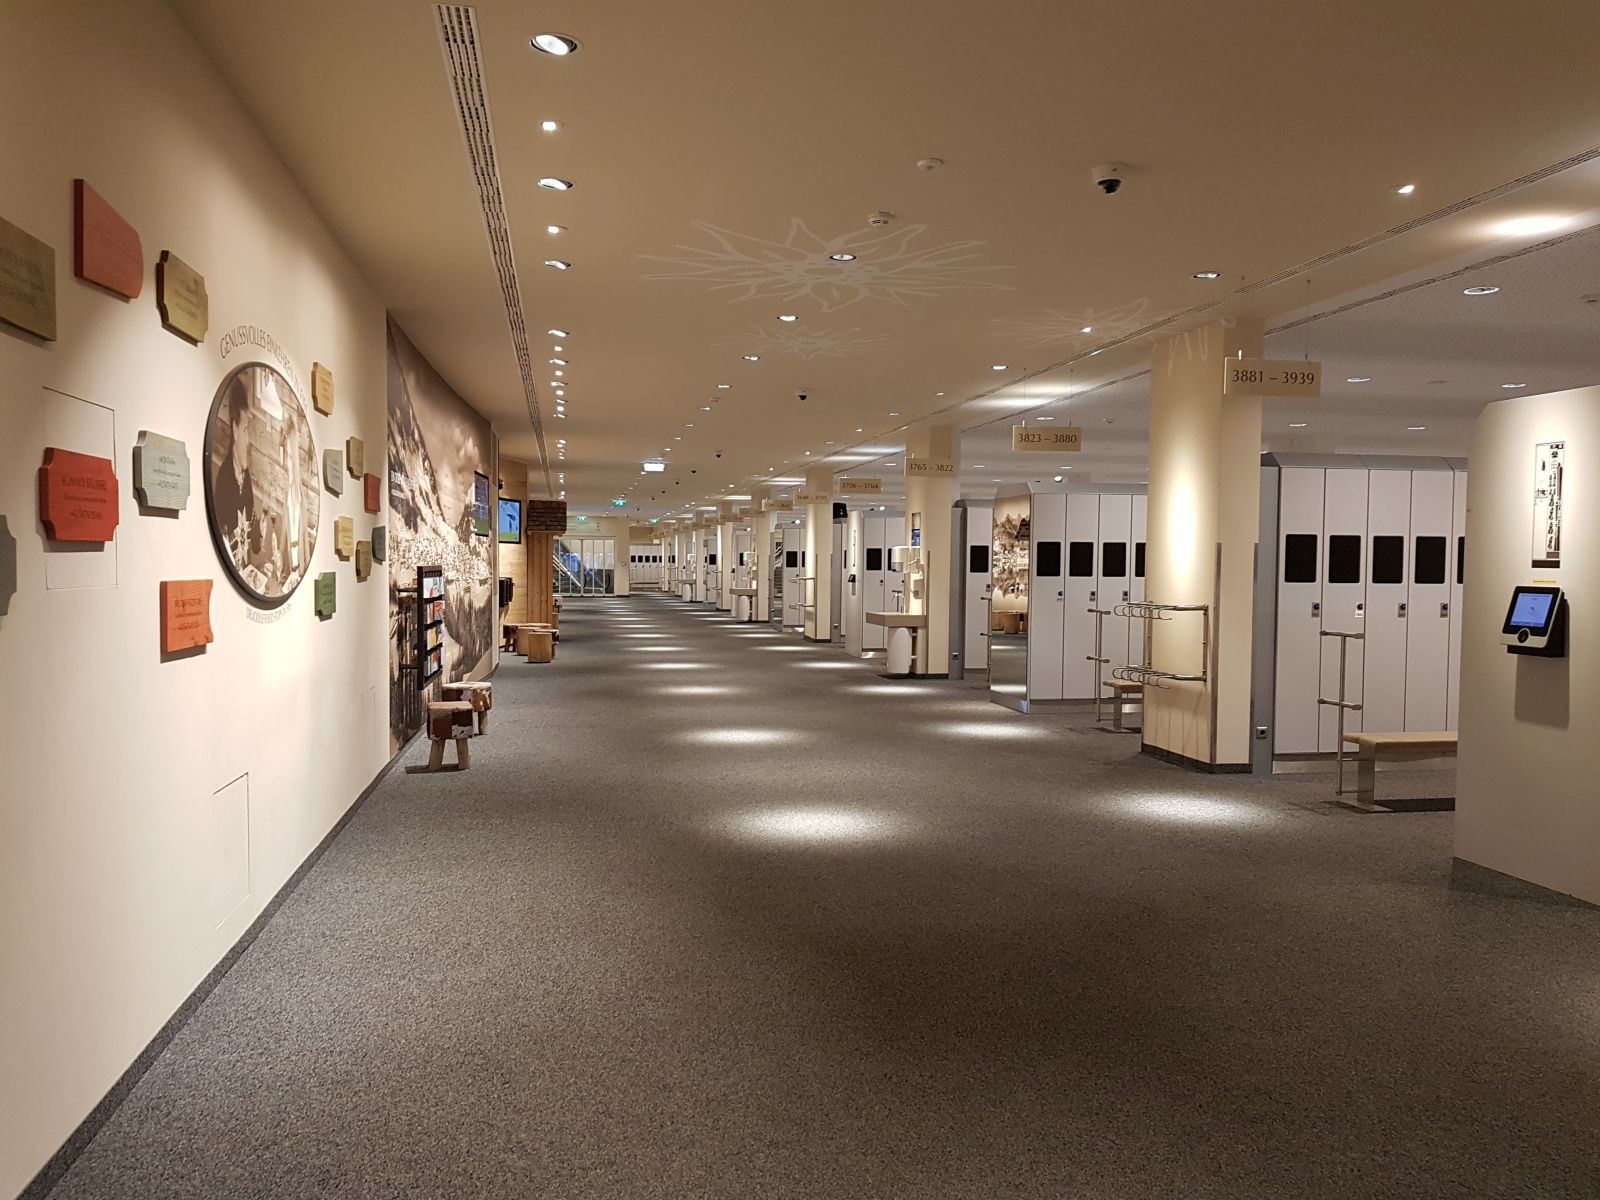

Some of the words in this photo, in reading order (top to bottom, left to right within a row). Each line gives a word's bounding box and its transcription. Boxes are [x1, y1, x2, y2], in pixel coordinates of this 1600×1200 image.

[220, 325, 266, 359] GENUSSVOLLES
[1232, 369, 1263, 383] 3881
[1282, 371, 1315, 385] 3939
[1018, 433, 1041, 443] 3823
[1053, 434, 1077, 444] 3880
[909, 463, 927, 471] 3765
[936, 464, 954, 472] 3822
